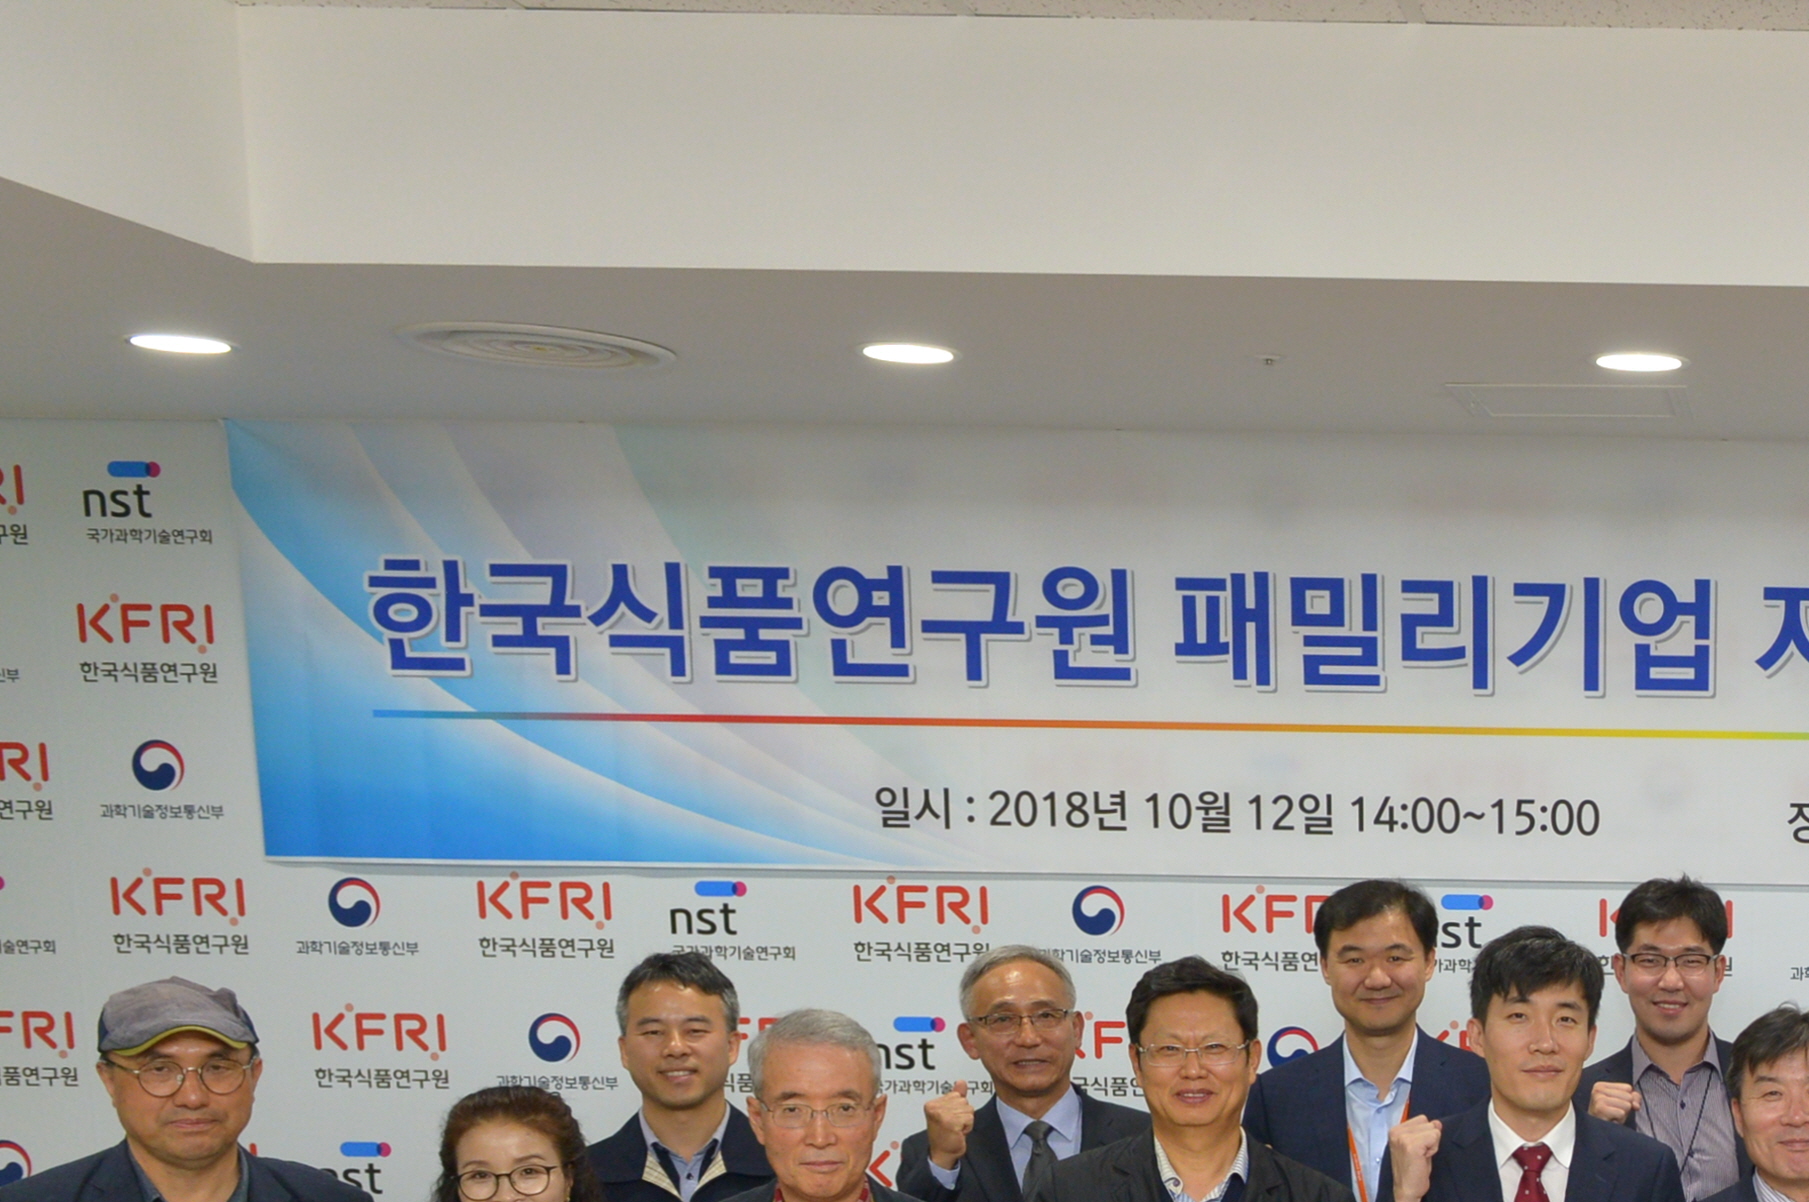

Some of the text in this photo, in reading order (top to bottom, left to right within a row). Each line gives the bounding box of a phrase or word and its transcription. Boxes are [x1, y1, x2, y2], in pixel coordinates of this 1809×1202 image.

[83, 484, 152, 518] nst
[86, 528, 212, 544] 국가과학기술연구회
[76, 603, 214, 644] KFRI
[366, 558, 1135, 685] 한국식품연구원
[1175, 572, 1710, 691] 패밀리기업
[79, 662, 217, 683] 한국식품연구원
[100, 804, 223, 820] 과학기술정보통신부
[876, 787, 950, 829] 일시
[989, 790, 1127, 831] 2018년
[1146, 791, 1230, 833] 10월
[1249, 794, 1333, 835] 12일
[1351, 796, 1599, 836] 14:00~15:00
[110, 877, 245, 916] KFRI
[477, 881, 612, 920] KFRI
[853, 885, 988, 925] KFRI
[670, 903, 737, 935] nst
[113, 933, 248, 955] 한국식품연구원
[296, 941, 419, 956] 과학기술정보통신부
[479, 937, 614, 958] 한국식품연구원
[312, 1013, 446, 1051] KFRI
[315, 1068, 449, 1089] 한국식품연구원
